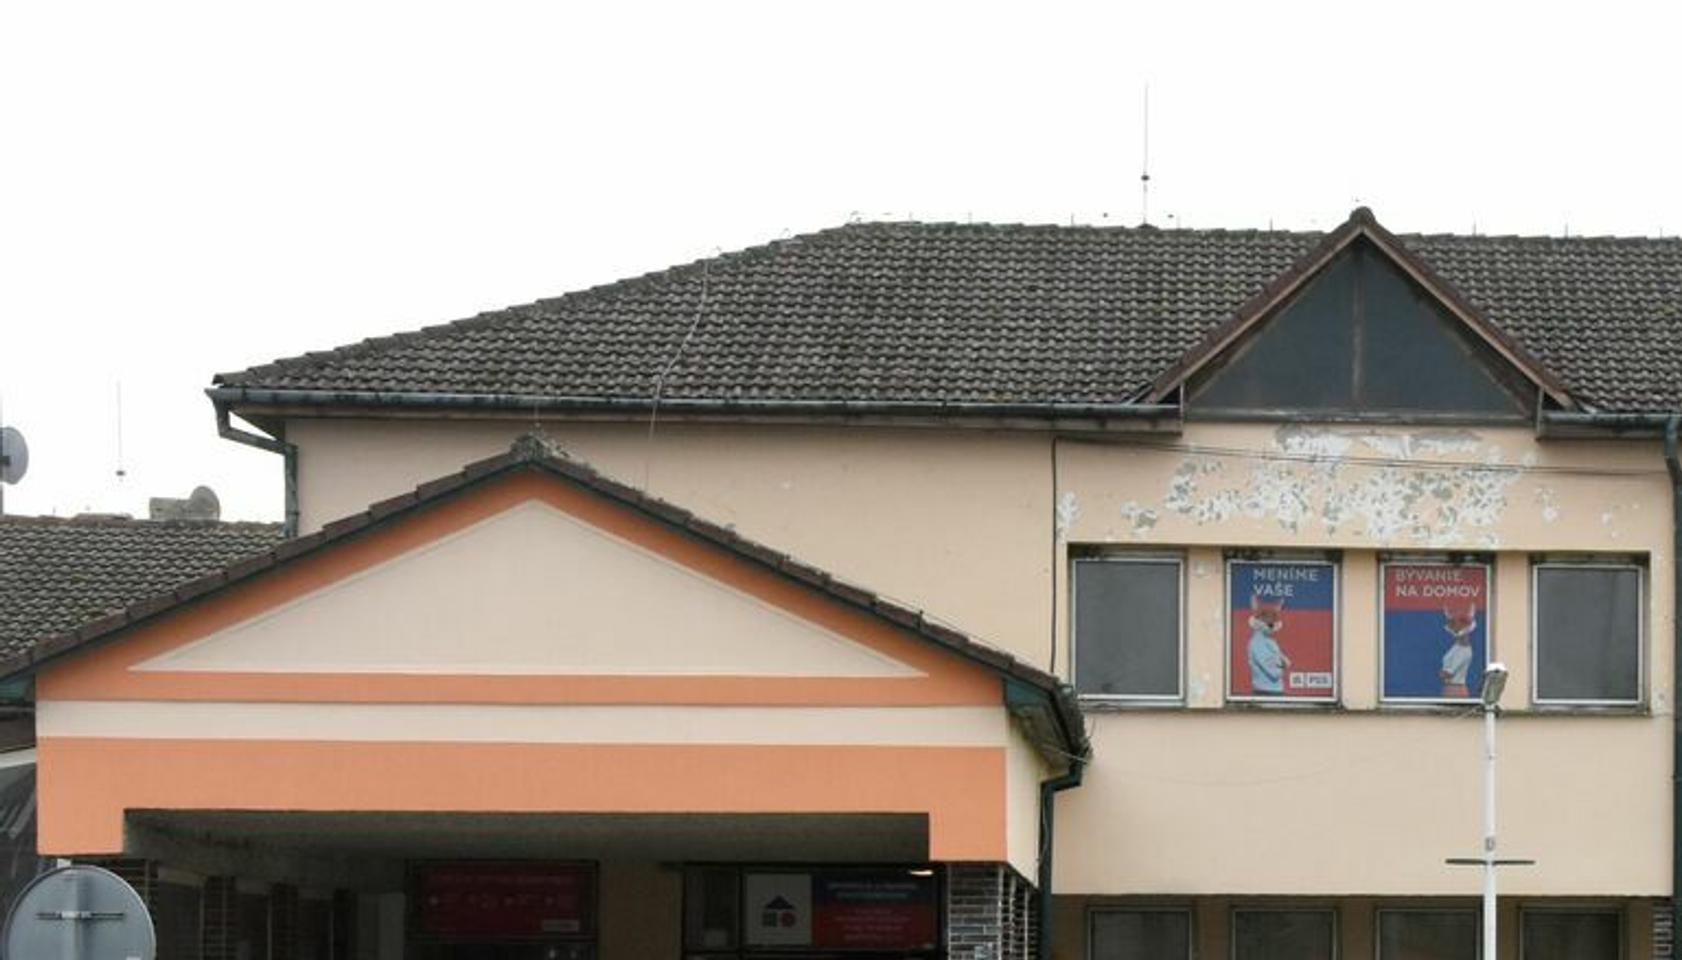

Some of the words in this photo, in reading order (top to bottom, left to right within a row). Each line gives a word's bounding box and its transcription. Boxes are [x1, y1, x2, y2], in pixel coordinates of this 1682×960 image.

[1252, 581, 1296, 598] VAŠE
[1395, 584, 1419, 598] NA
[1423, 584, 1481, 598] DOMOV
